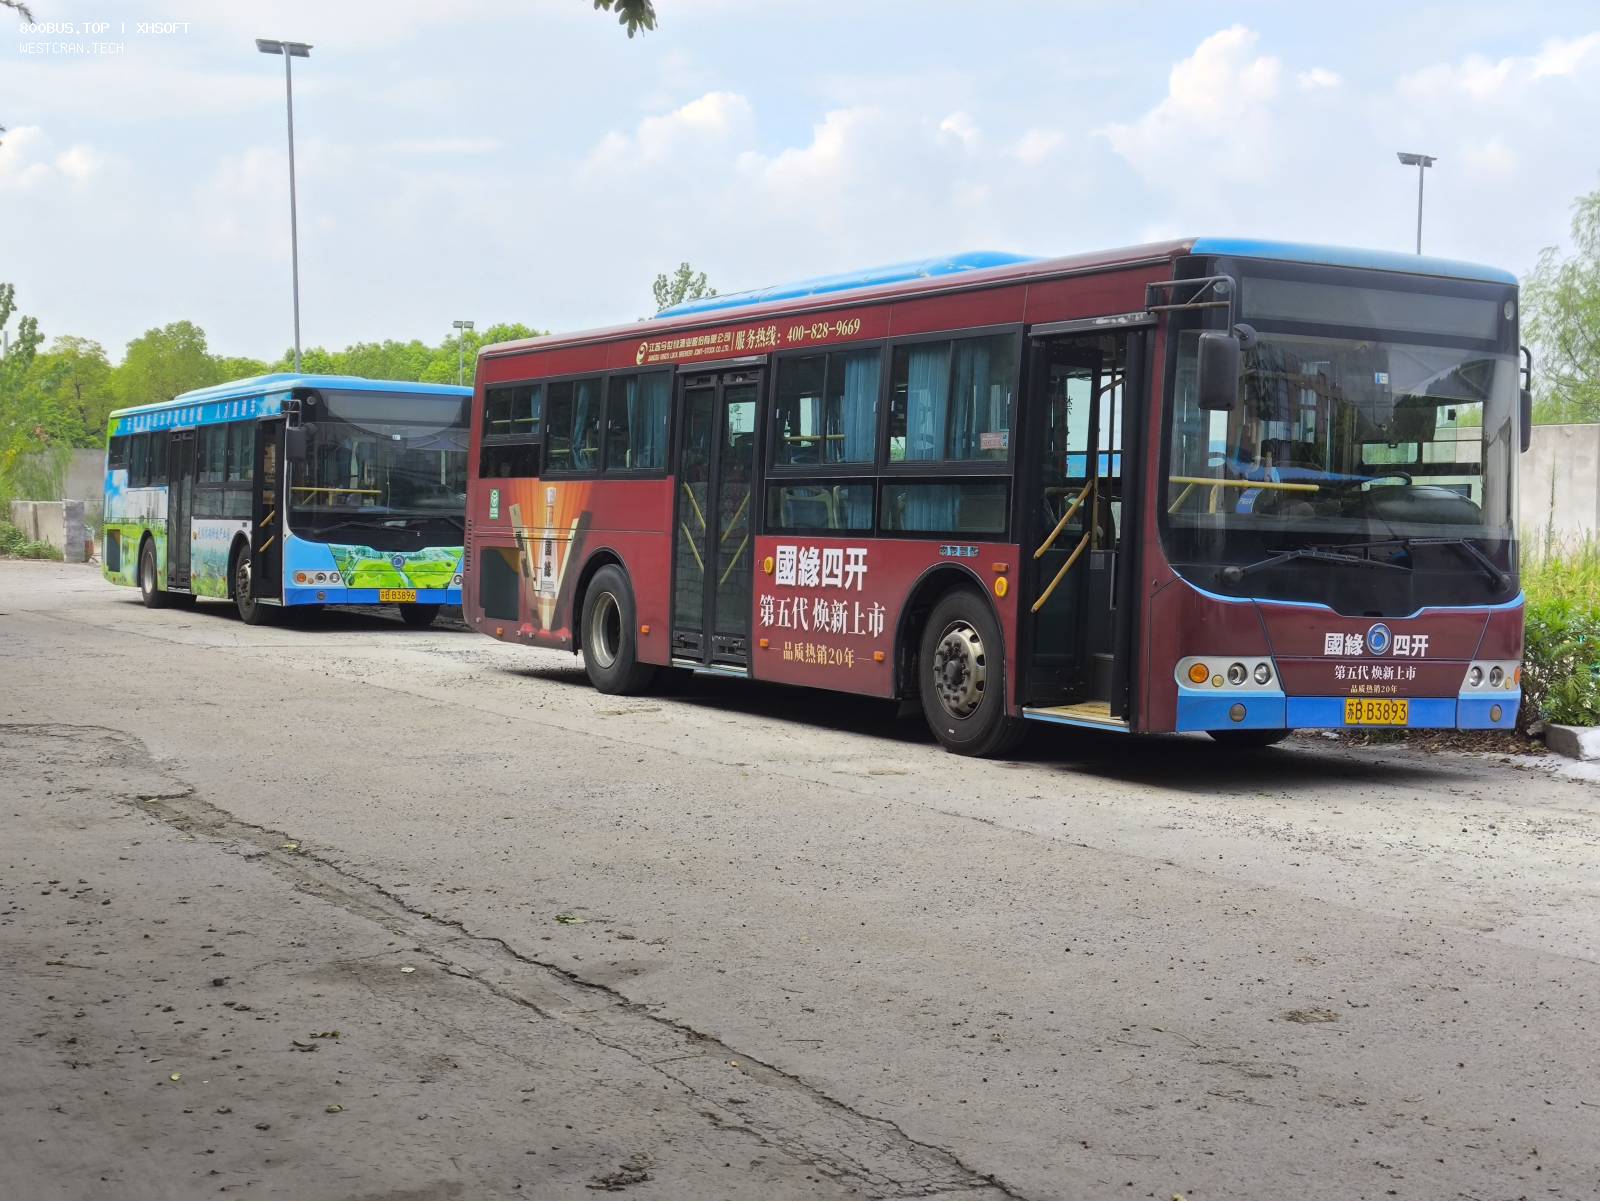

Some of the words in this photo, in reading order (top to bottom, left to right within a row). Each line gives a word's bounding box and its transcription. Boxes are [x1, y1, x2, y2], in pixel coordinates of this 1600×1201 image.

[786, 318, 861, 342] 400-828-9669
[776, 545, 868, 591] 國緣四开
[759, 594, 808, 631] 第五代
[812, 600, 886, 638] 焕新上市
[783, 642, 855, 668] 品质热销20年
[1393, 634, 1429, 657] 四开
[1335, 665, 1369, 680] 第五代
[1371, 665, 1417, 681] 焕新上市
